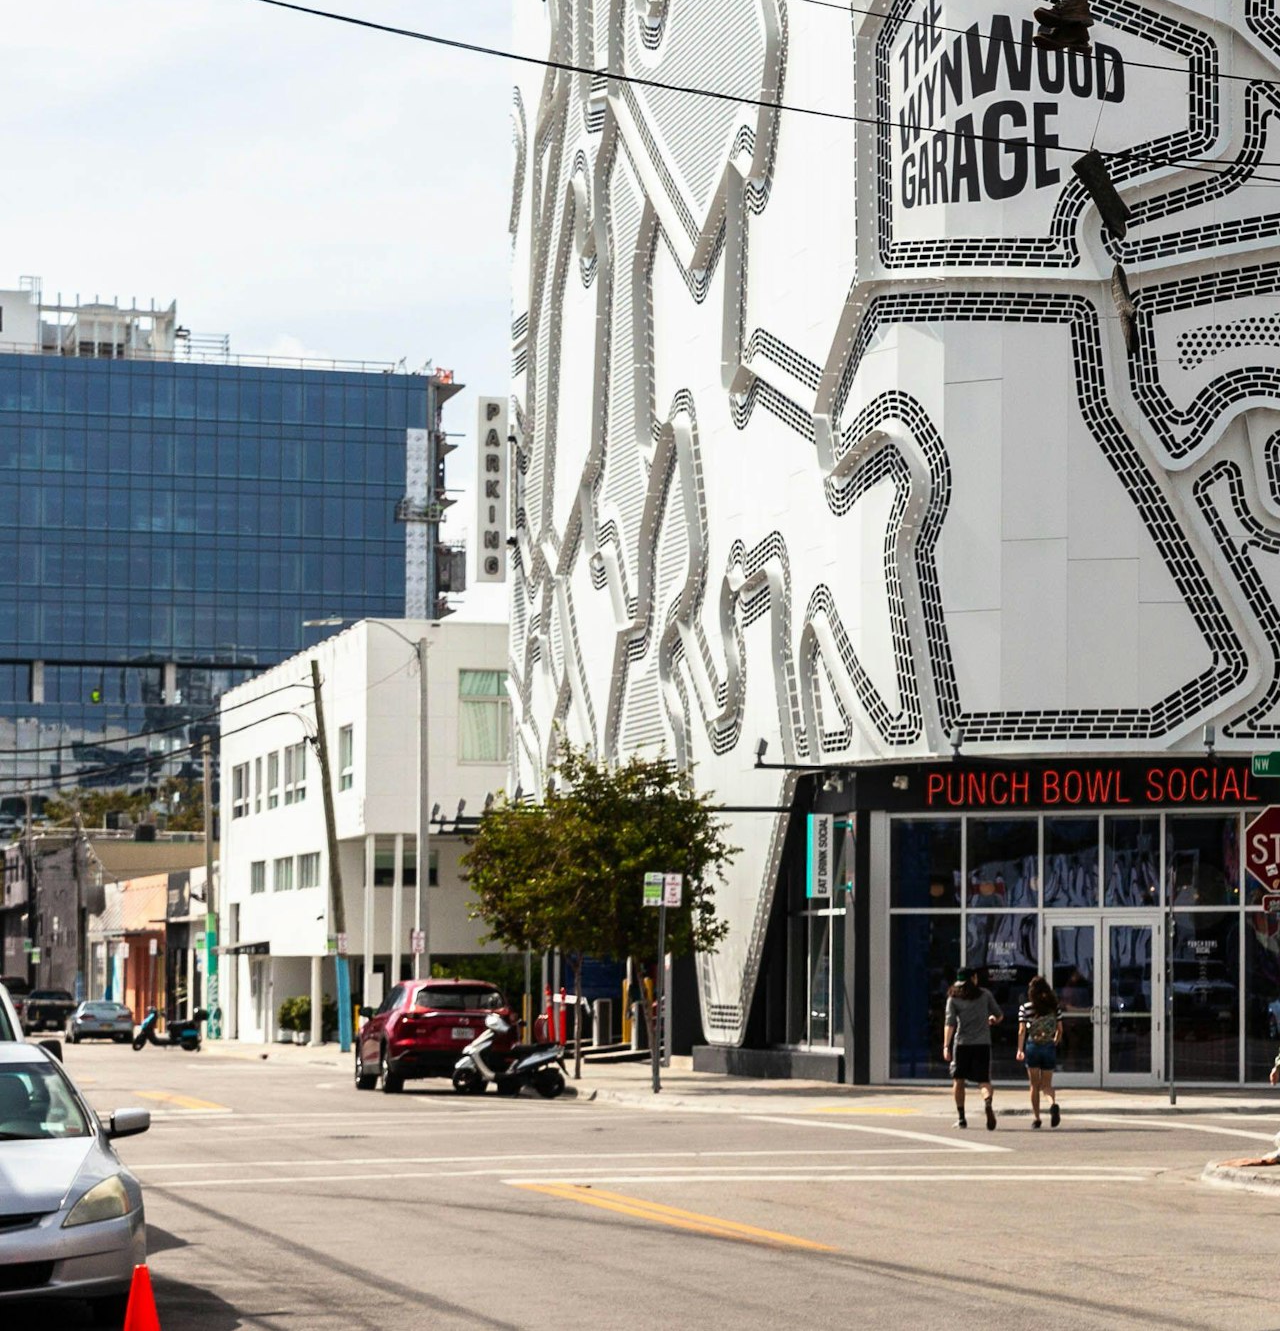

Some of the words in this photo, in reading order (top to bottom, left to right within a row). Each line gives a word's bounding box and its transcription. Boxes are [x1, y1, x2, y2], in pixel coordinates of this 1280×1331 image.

[899, 14, 1125, 155] WYNWOOD
[901, 99, 1060, 209] GARAGE
[485, 402, 501, 576] PARKING
[1254, 758, 1269, 771] NW
[928, 771, 1030, 806] PUNCH
[1042, 769, 1131, 804] BOWL
[1145, 767, 1259, 802] SOCIAL
[818, 817, 828, 848] SOCIAL
[818, 849, 828, 876] DRINK
[818, 878, 827, 894] EAT
